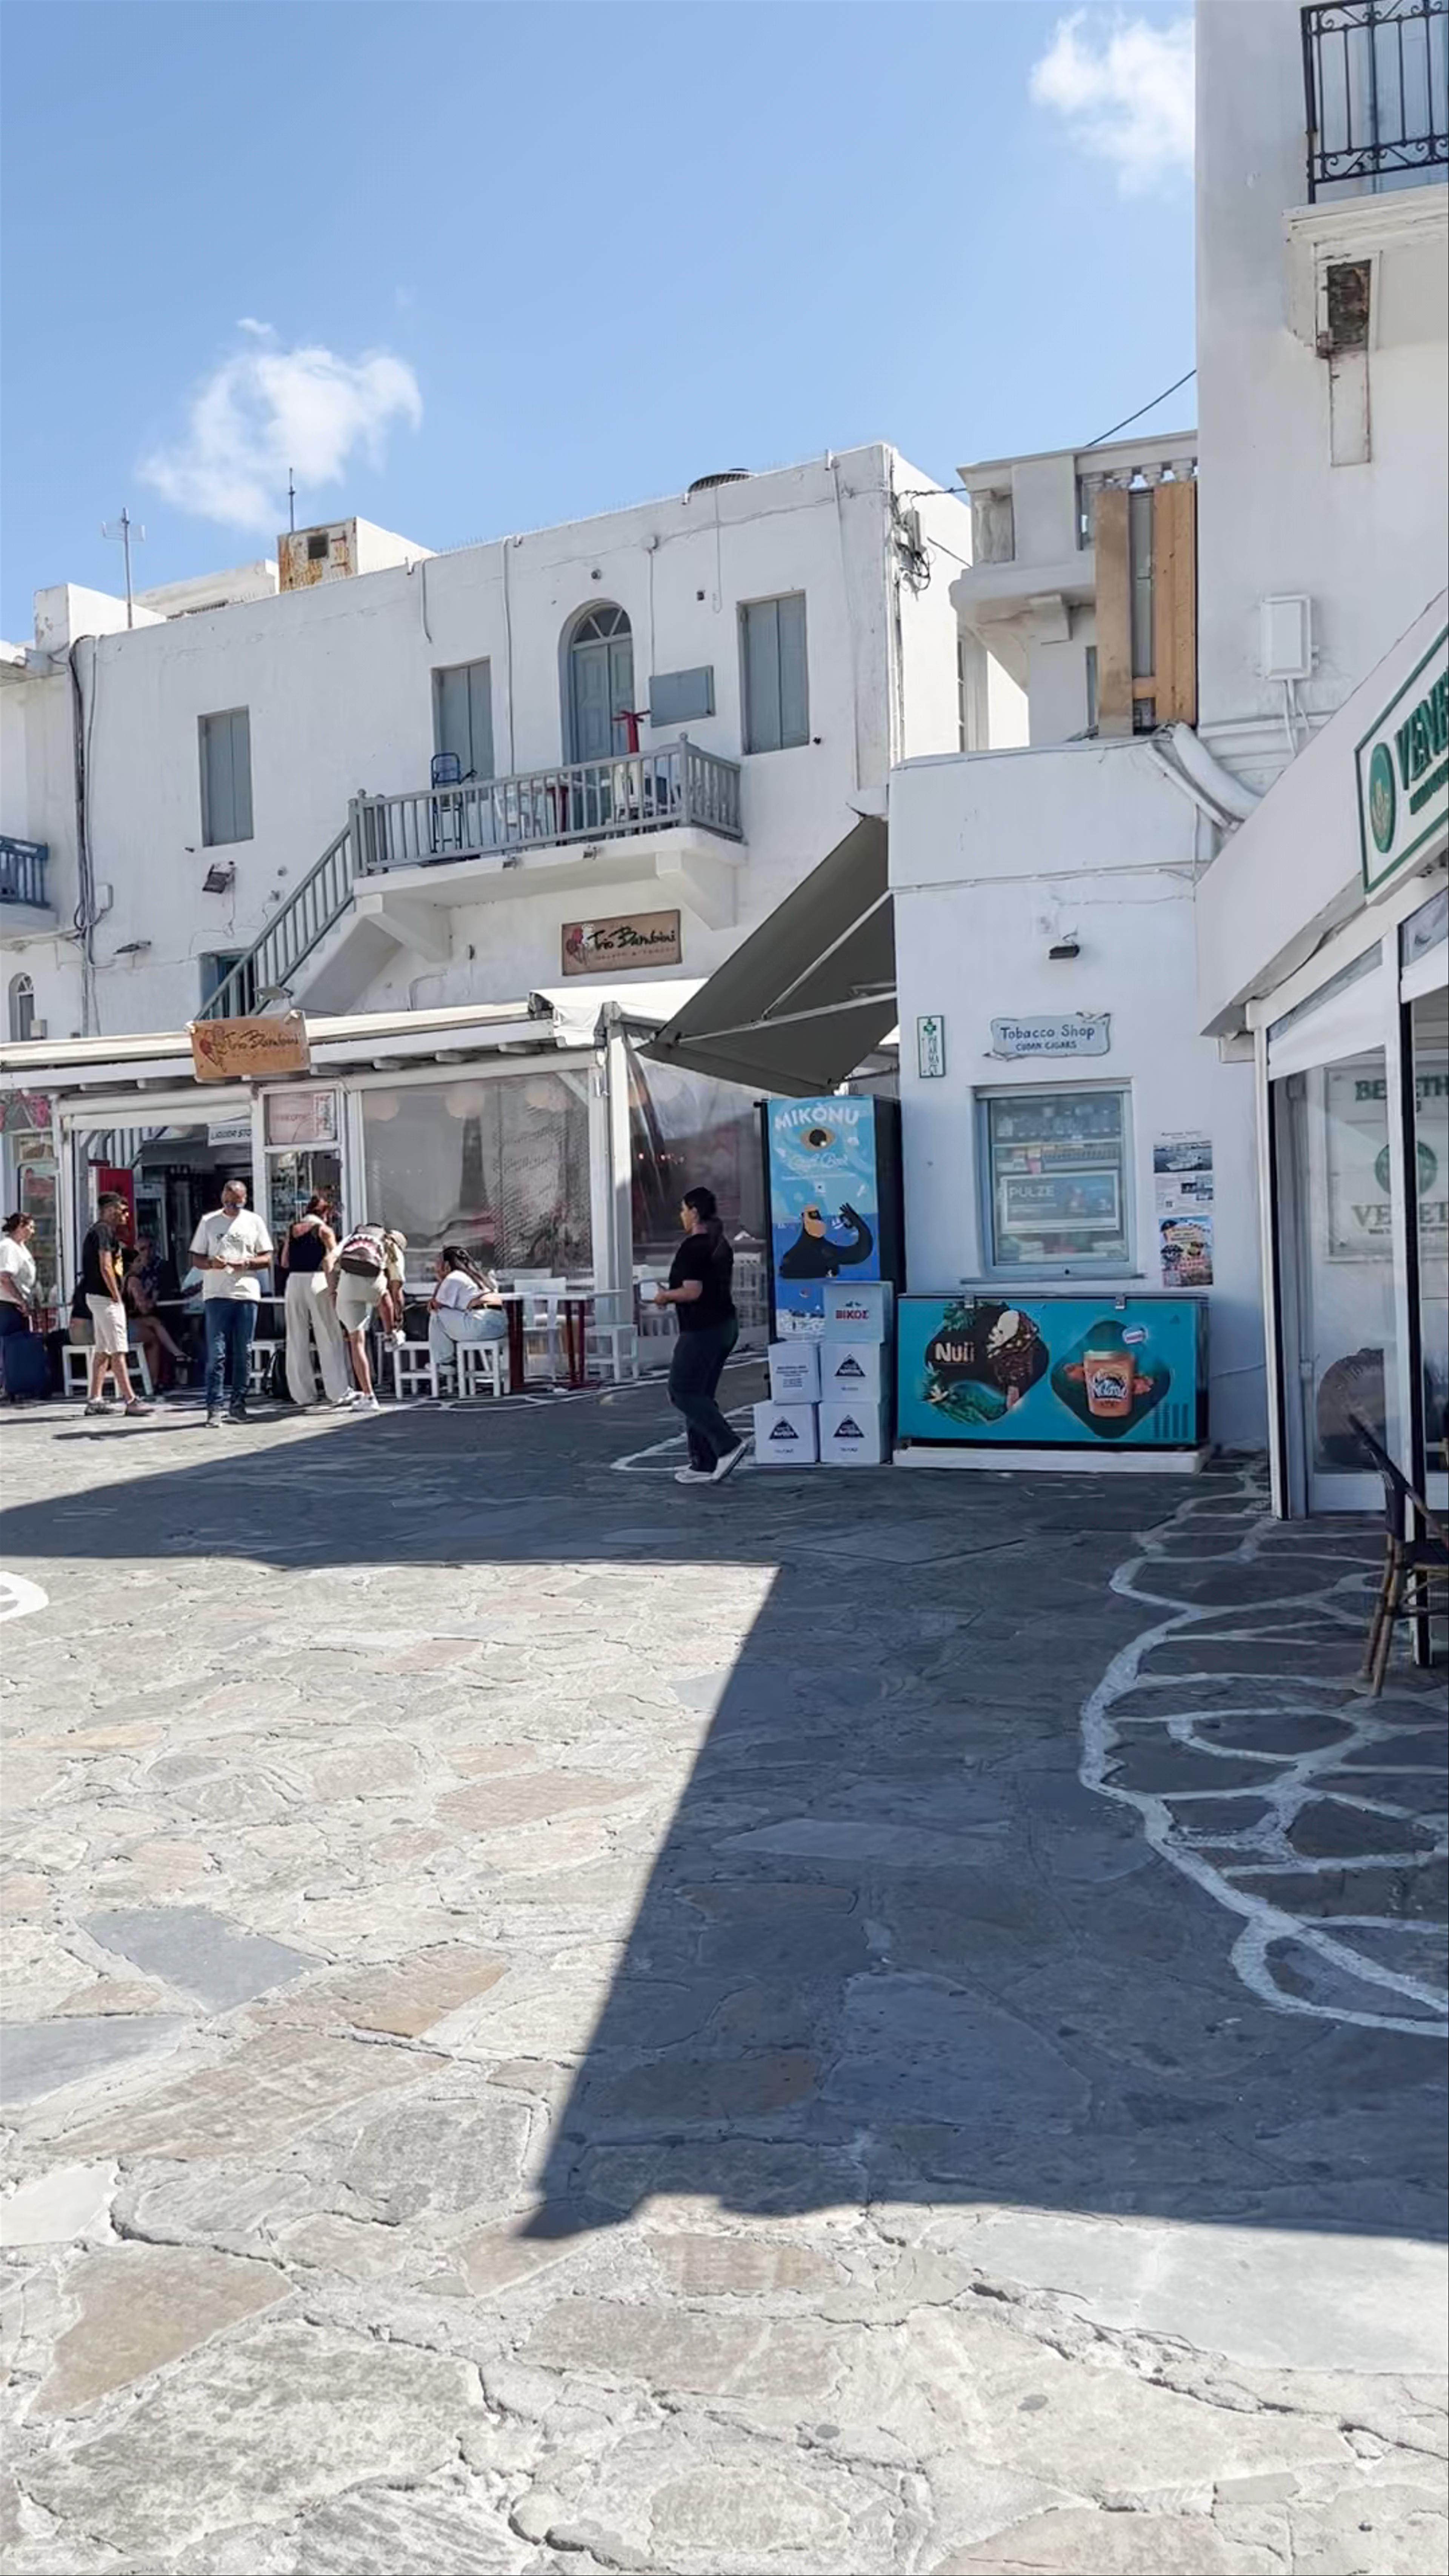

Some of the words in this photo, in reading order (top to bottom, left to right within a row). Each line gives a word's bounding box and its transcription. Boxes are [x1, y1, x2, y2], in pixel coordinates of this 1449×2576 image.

[1000, 1027, 1055, 1040] Tobacco
[1061, 1024, 1095, 1040] Shop
[1016, 1043, 1043, 1052] CUBAN
[1045, 1041, 1077, 1050] CIGARS
[1009, 1184, 1055, 1198] PULZE
